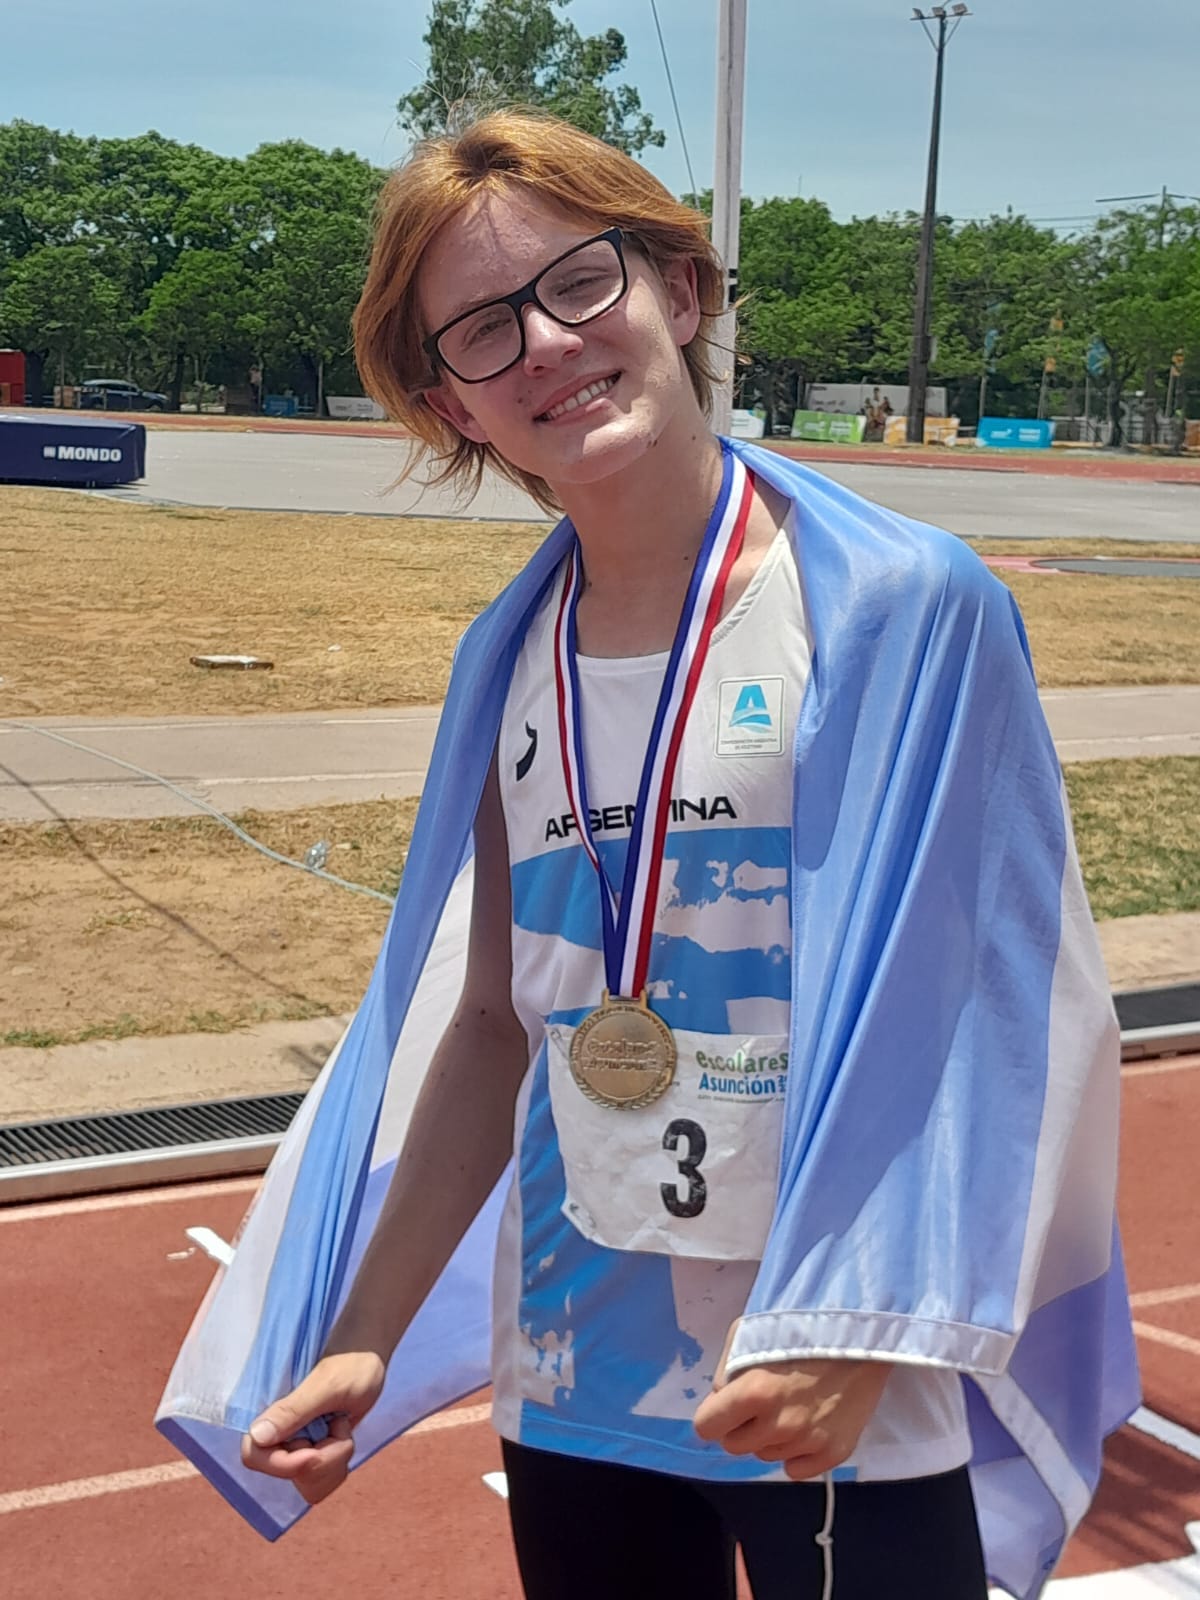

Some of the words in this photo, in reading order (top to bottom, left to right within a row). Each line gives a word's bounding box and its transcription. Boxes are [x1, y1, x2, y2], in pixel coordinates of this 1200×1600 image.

[58, 446, 122, 462] MONDO
[545, 796, 737, 842] ARGEINA
[695, 1050, 789, 1073] escolares
[698, 1071, 776, 1095] Asunción
[660, 1118, 708, 1218] 3
